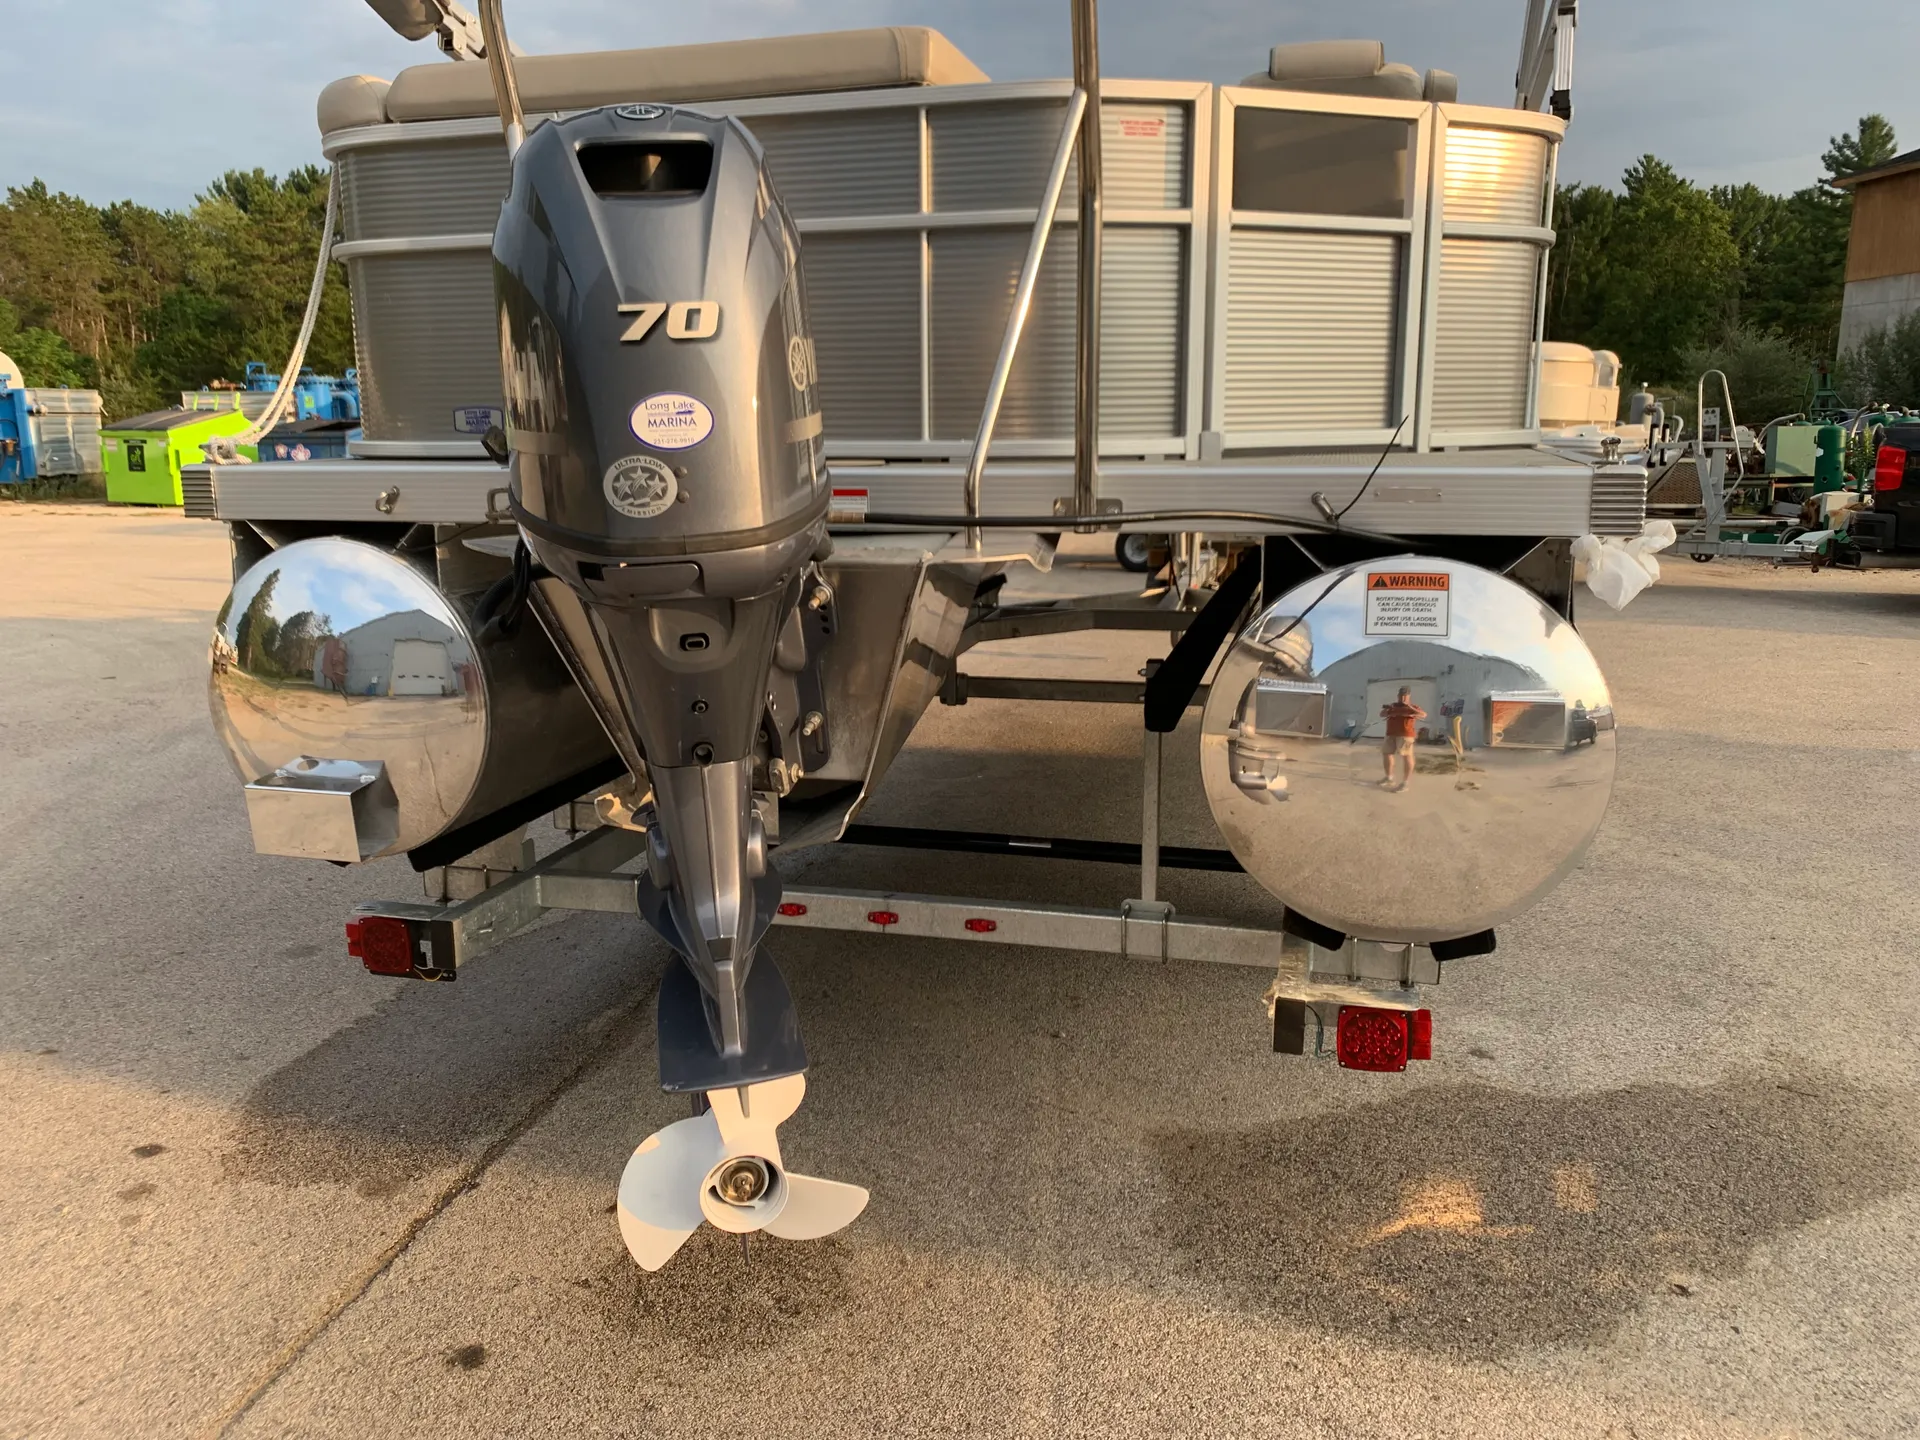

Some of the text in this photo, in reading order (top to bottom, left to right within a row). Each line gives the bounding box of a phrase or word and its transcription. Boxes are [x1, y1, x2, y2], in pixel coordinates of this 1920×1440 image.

[617, 301, 719, 341] 70
[644, 400, 695, 411] Long Lake
[647, 417, 697, 428] MARINA
[621, 505, 662, 516] EMISSION
[1388, 575, 1445, 588] WARNING
